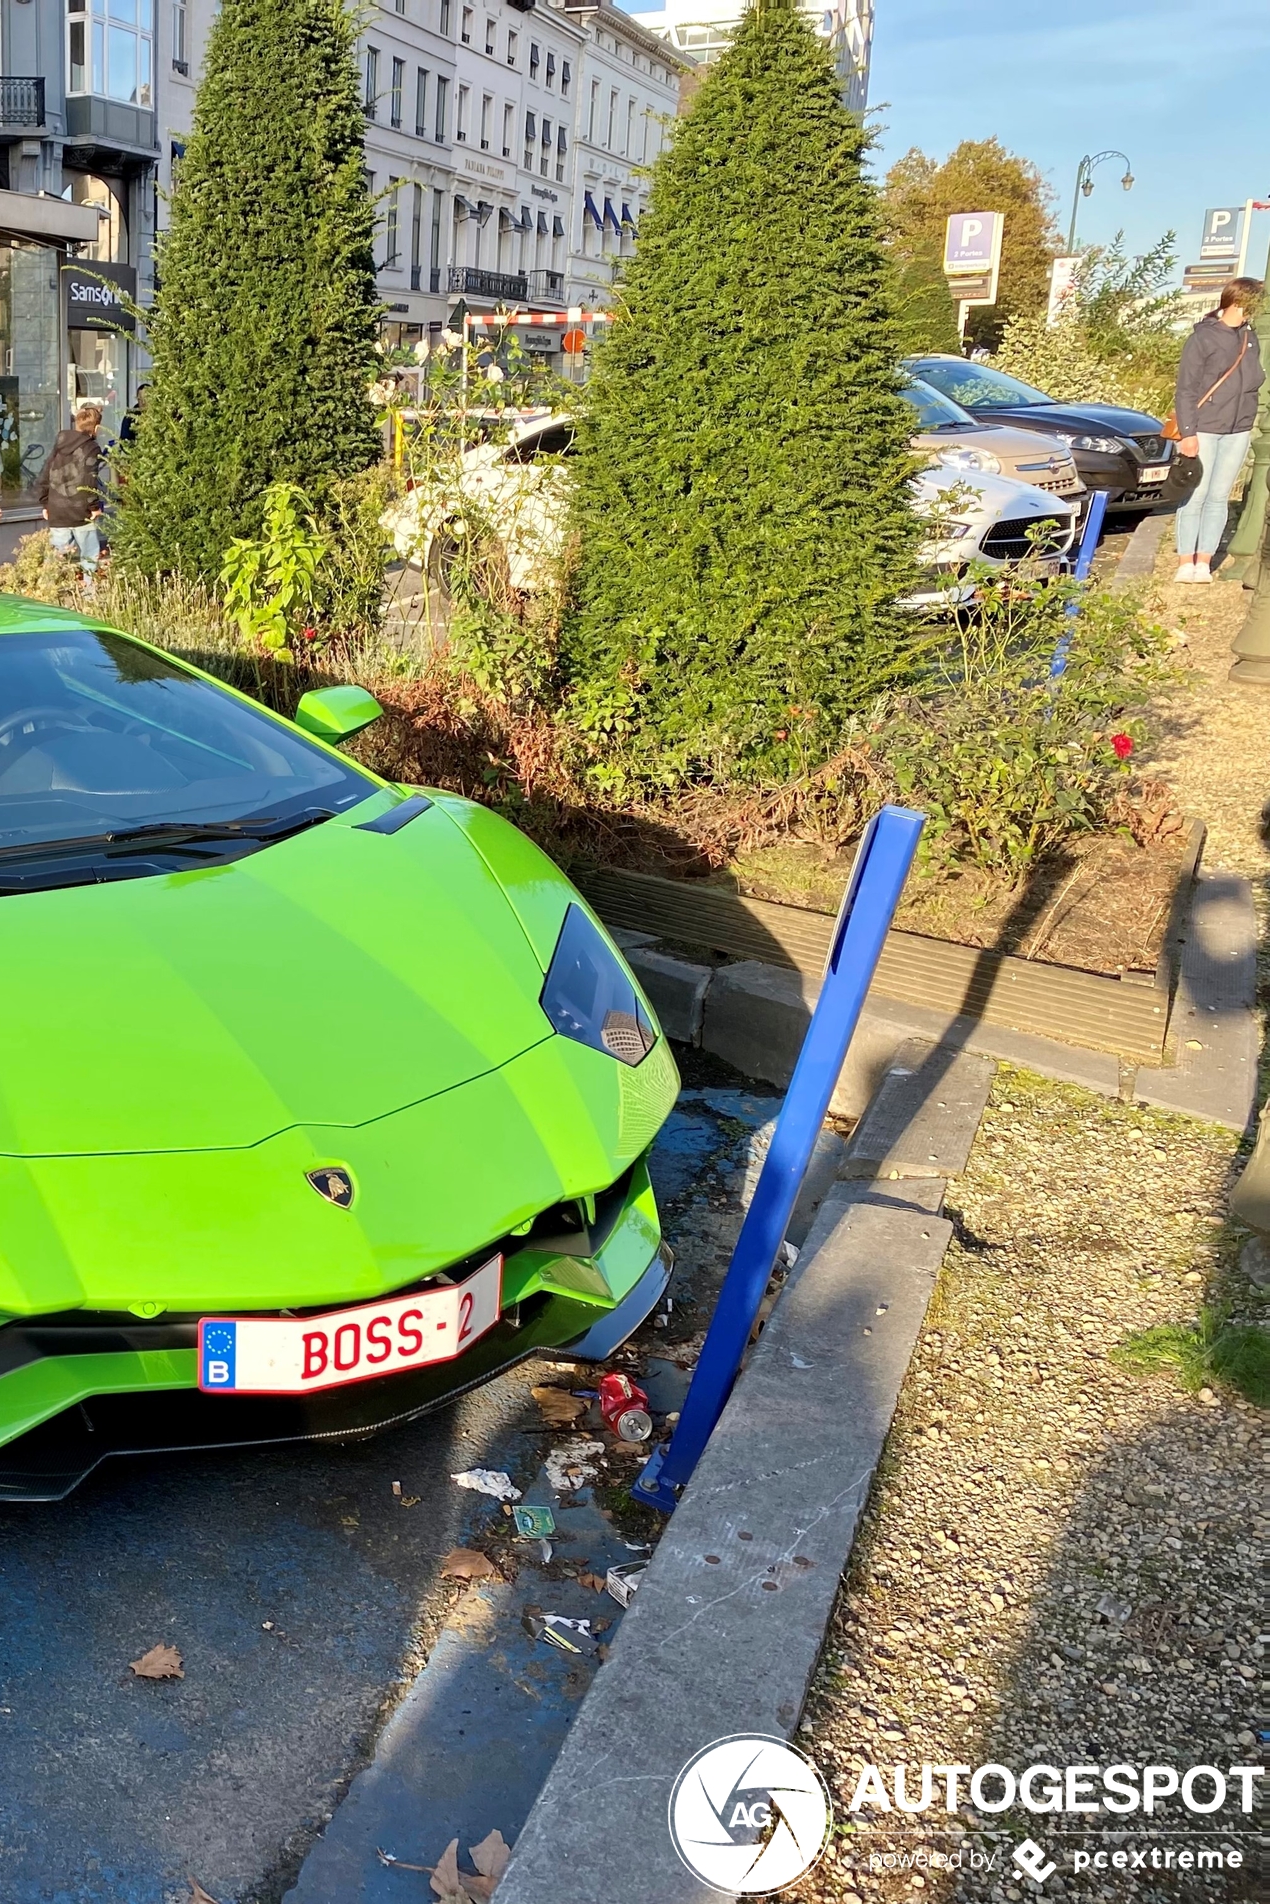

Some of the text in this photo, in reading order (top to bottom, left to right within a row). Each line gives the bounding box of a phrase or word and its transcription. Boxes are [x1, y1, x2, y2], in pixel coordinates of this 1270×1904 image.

[960, 219, 983, 247] P
[1210, 210, 1232, 234] P
[953, 250, 983, 258] 2 Portes
[208, 1360, 229, 1383] B
